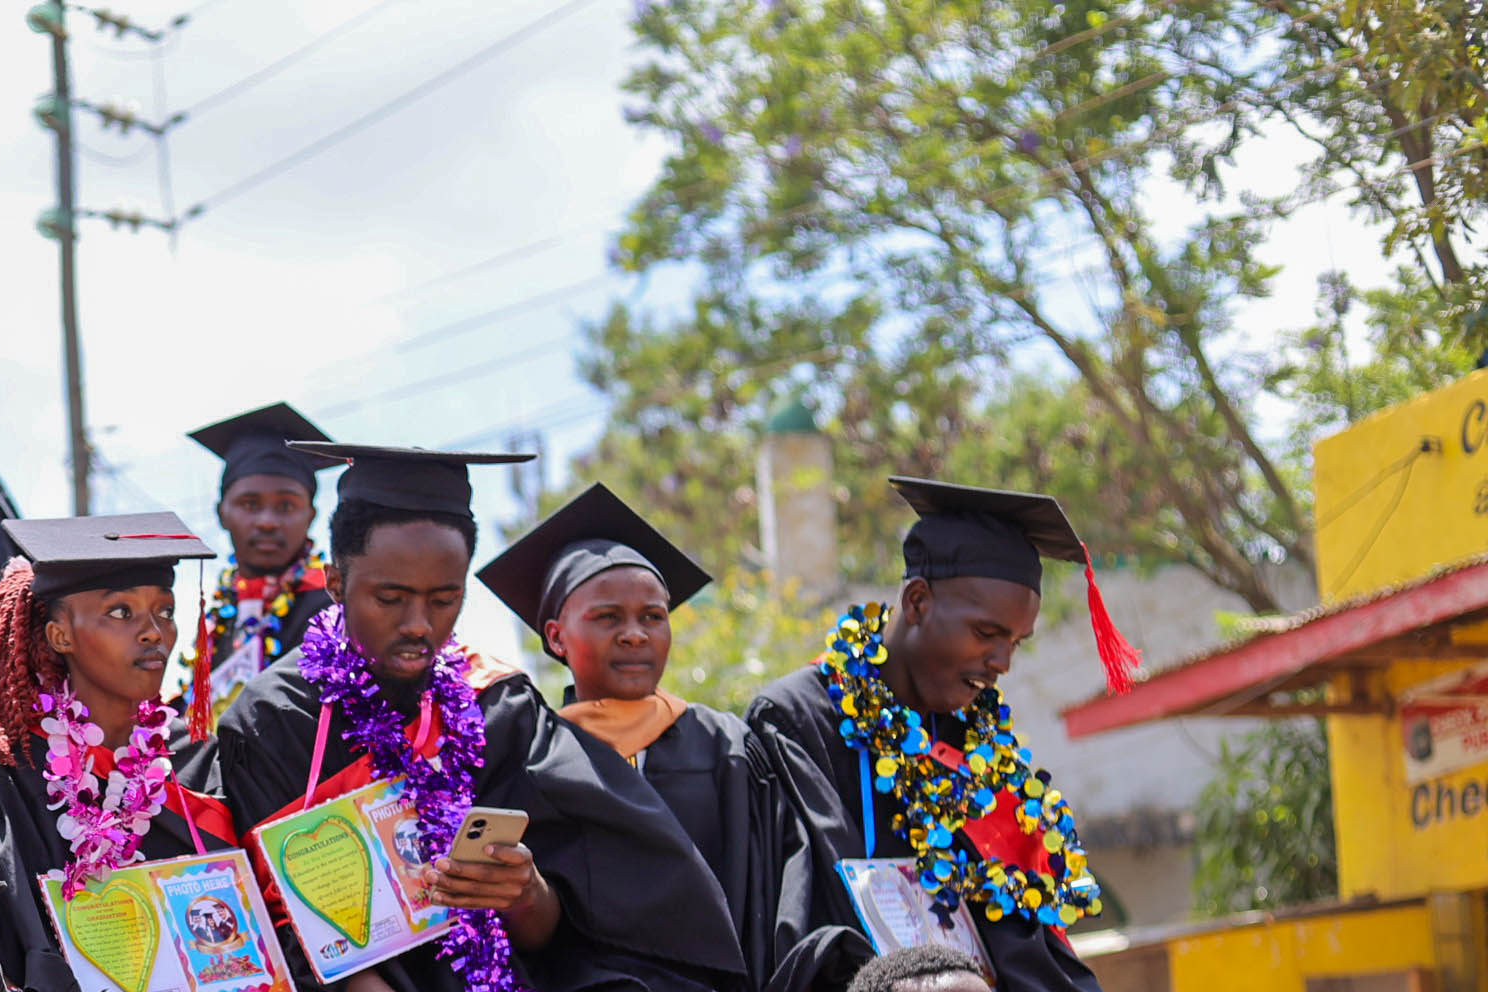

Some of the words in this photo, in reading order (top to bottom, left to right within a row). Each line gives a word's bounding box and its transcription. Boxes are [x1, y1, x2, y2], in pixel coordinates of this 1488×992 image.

[1411, 778, 1488, 831] Che
[167, 881, 200, 897] PHOTO
[203, 876, 231, 892] HERE
